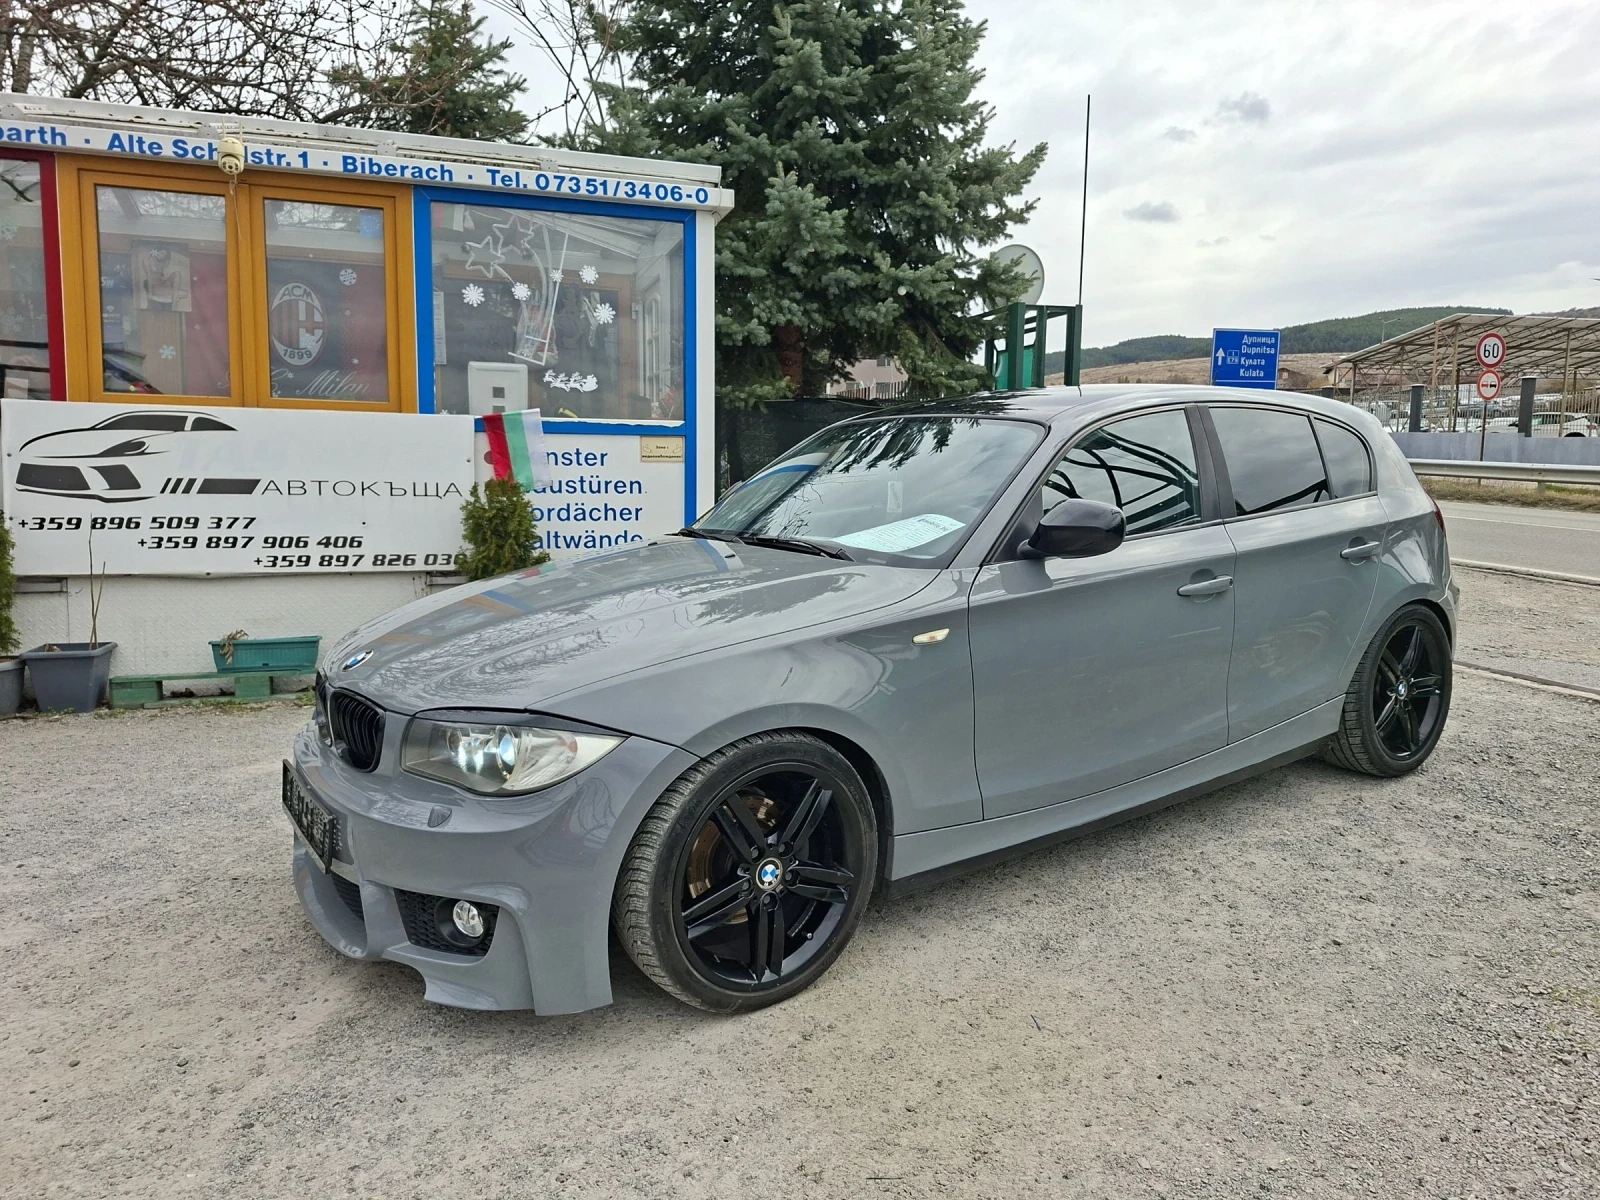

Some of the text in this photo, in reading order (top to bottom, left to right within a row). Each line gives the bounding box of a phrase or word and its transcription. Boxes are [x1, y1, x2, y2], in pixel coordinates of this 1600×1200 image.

[106, 132, 164, 157] Alte
[171, 138, 292, 168] Schlstr.
[341, 154, 455, 182] Biberach
[486, 168, 529, 189] Tel.
[534, 173, 710, 205] 07351/3406-0
[280, 284, 315, 303] ACM
[1242, 334, 1275, 344] Дупница
[282, 348, 313, 360] 1899
[1242, 345, 1275, 355] Dupnitsa
[1483, 342, 1500, 359] 60
[1241, 357, 1265, 366] Кулата
[1240, 368, 1264, 377] Kulata
[545, 447, 609, 467] nster
[260, 479, 464, 500] АВТОКЪЩА
[529, 502, 644, 522] ordächer
[17, 516, 257, 531] +359 896 509 377
[137, 535, 364, 550] +359 897 906 406
[253, 554, 312, 568] +359
[317, 554, 365, 568] 897
[371, 553, 418, 567] 826
